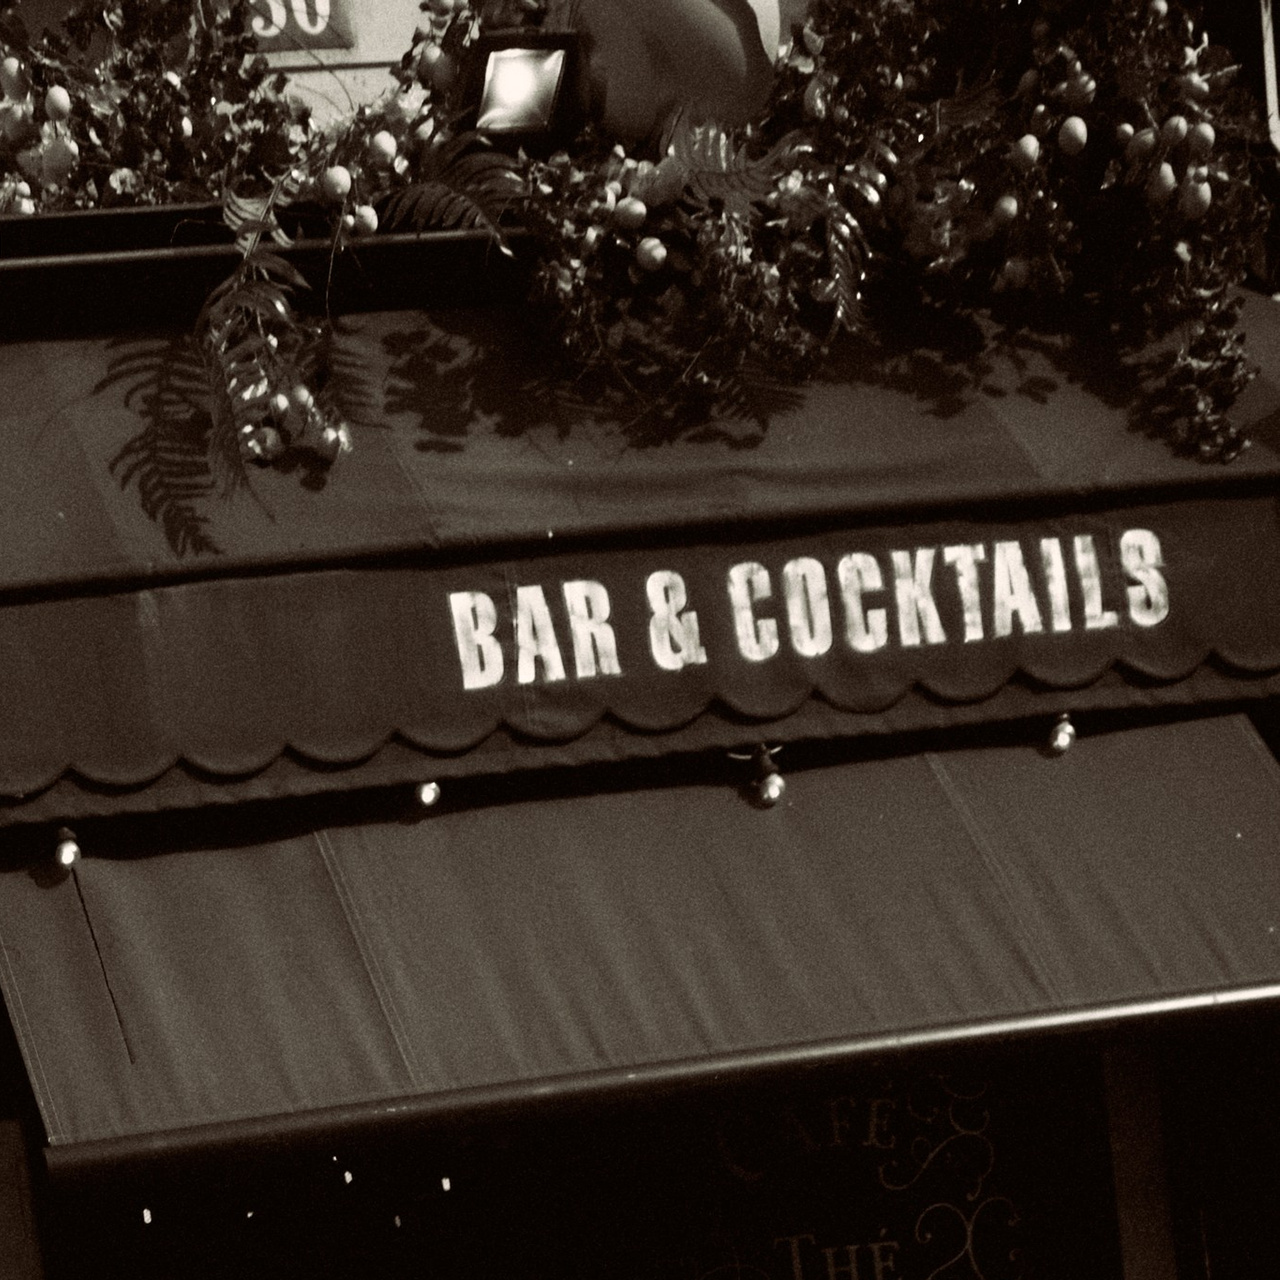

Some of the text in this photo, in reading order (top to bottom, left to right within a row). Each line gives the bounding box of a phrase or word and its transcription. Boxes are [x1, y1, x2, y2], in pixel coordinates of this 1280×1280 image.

[448, 529, 1170, 691] BAR & COCKTAILS
